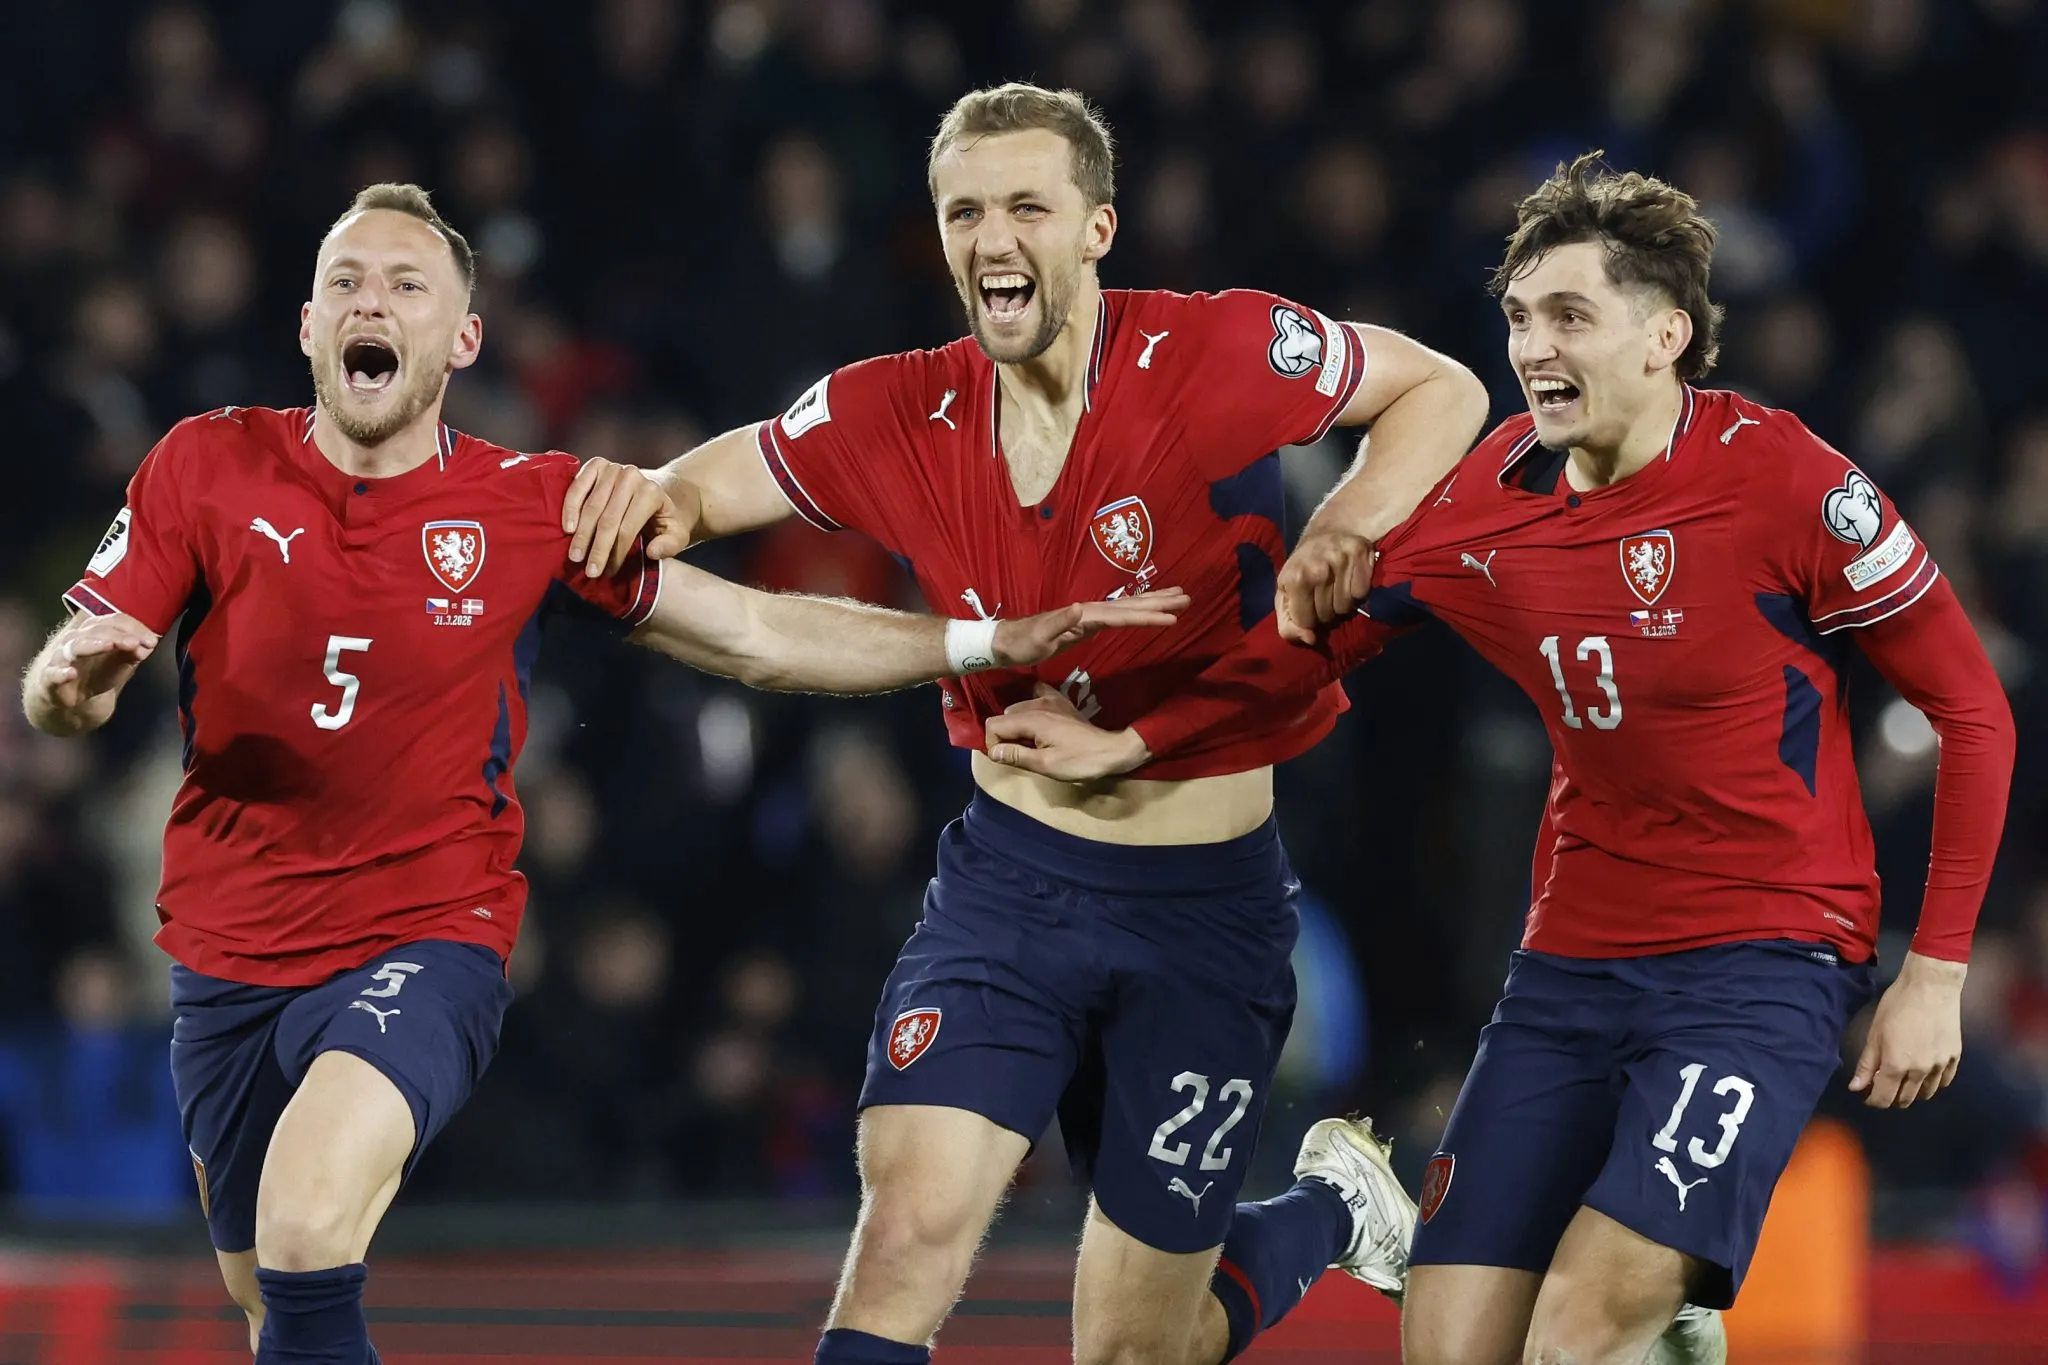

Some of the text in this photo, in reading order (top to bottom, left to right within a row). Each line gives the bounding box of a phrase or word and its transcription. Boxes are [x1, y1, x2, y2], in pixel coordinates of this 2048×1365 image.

[1846, 561, 1866, 575] UEFA
[1849, 530, 1910, 583] FOUNDATION
[433, 614, 473, 626] 31.3.2026
[310, 634, 374, 731] 5
[1538, 635, 1623, 730] 13
[360, 961, 425, 998] 5
[1147, 1070, 1254, 1171] 22
[1652, 1063, 1755, 1169] 13
